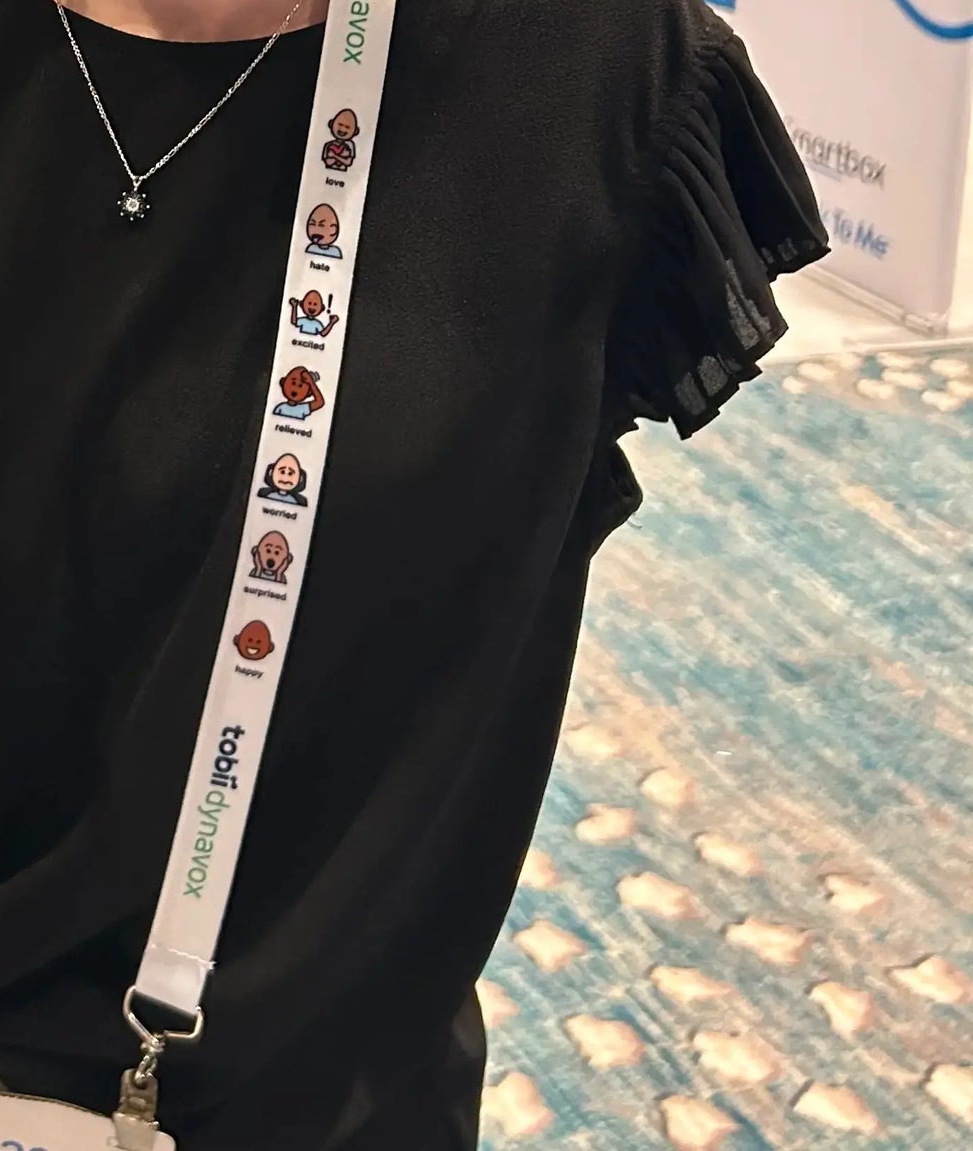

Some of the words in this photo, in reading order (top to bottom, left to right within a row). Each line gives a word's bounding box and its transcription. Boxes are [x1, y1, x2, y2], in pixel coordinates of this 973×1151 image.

[325, 177, 345, 188] love
[291, 338, 325, 351] excited
[274, 424, 312, 438] relieved
[262, 506, 298, 520] worried
[243, 585, 287, 601] surprised
[234, 664, 265, 679] happy
